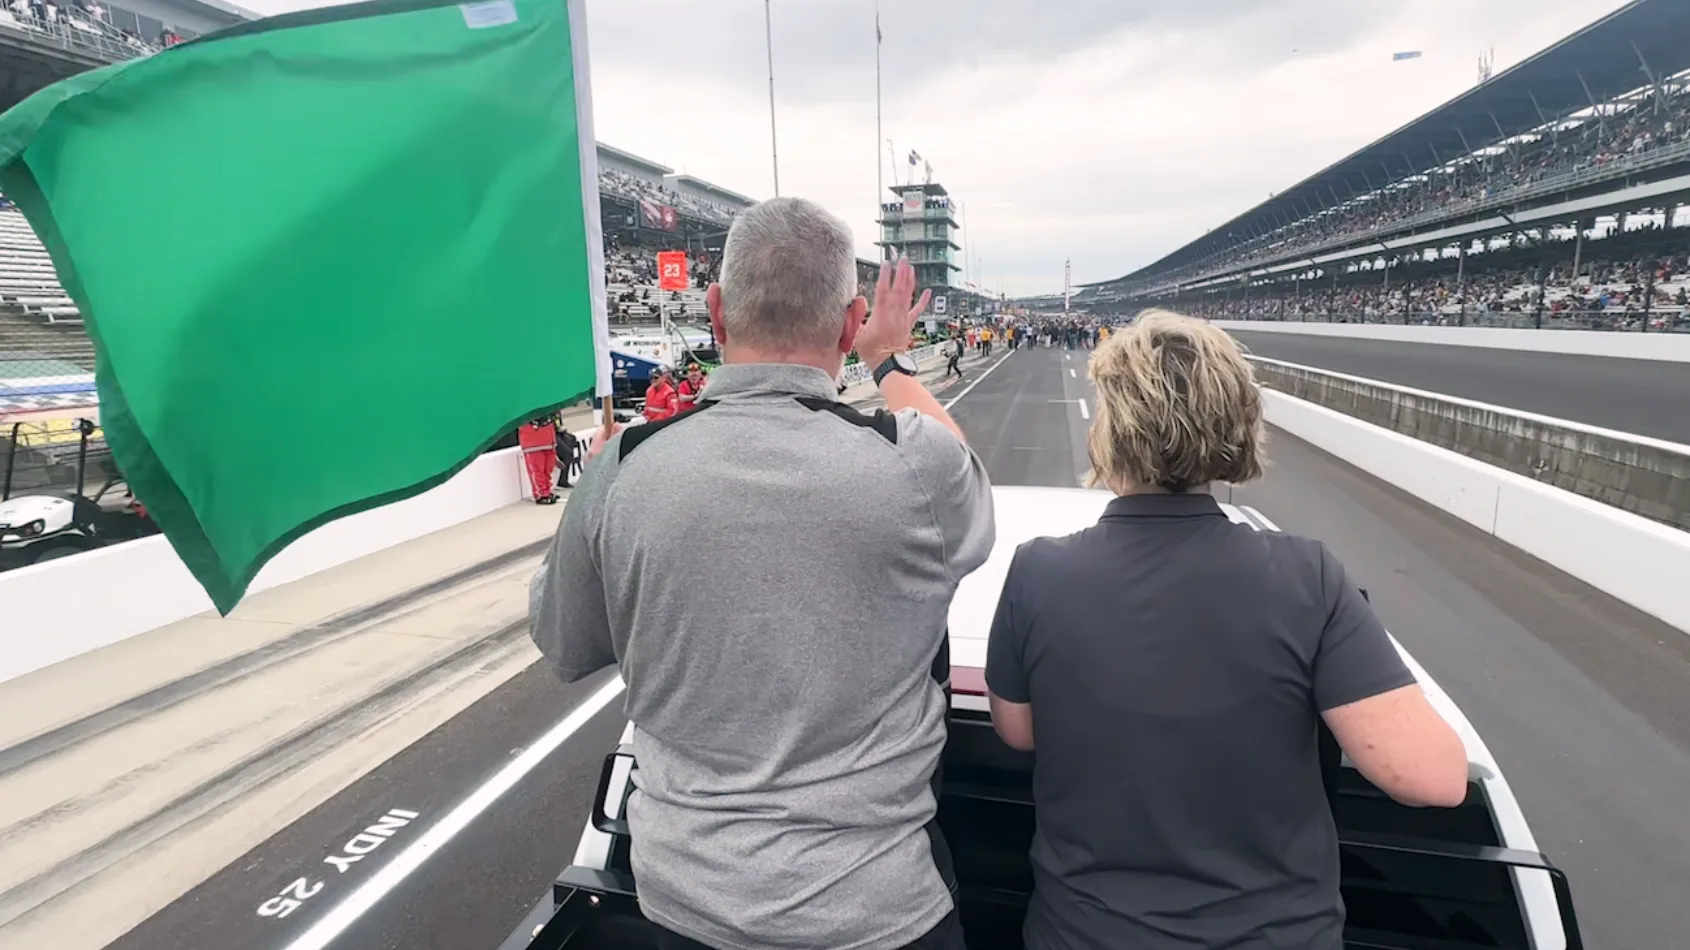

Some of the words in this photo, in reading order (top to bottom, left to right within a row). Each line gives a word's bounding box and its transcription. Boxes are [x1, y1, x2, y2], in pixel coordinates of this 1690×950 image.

[664, 264, 680, 277] 23
[324, 808, 420, 873] INDY
[256, 877, 324, 919] 25
